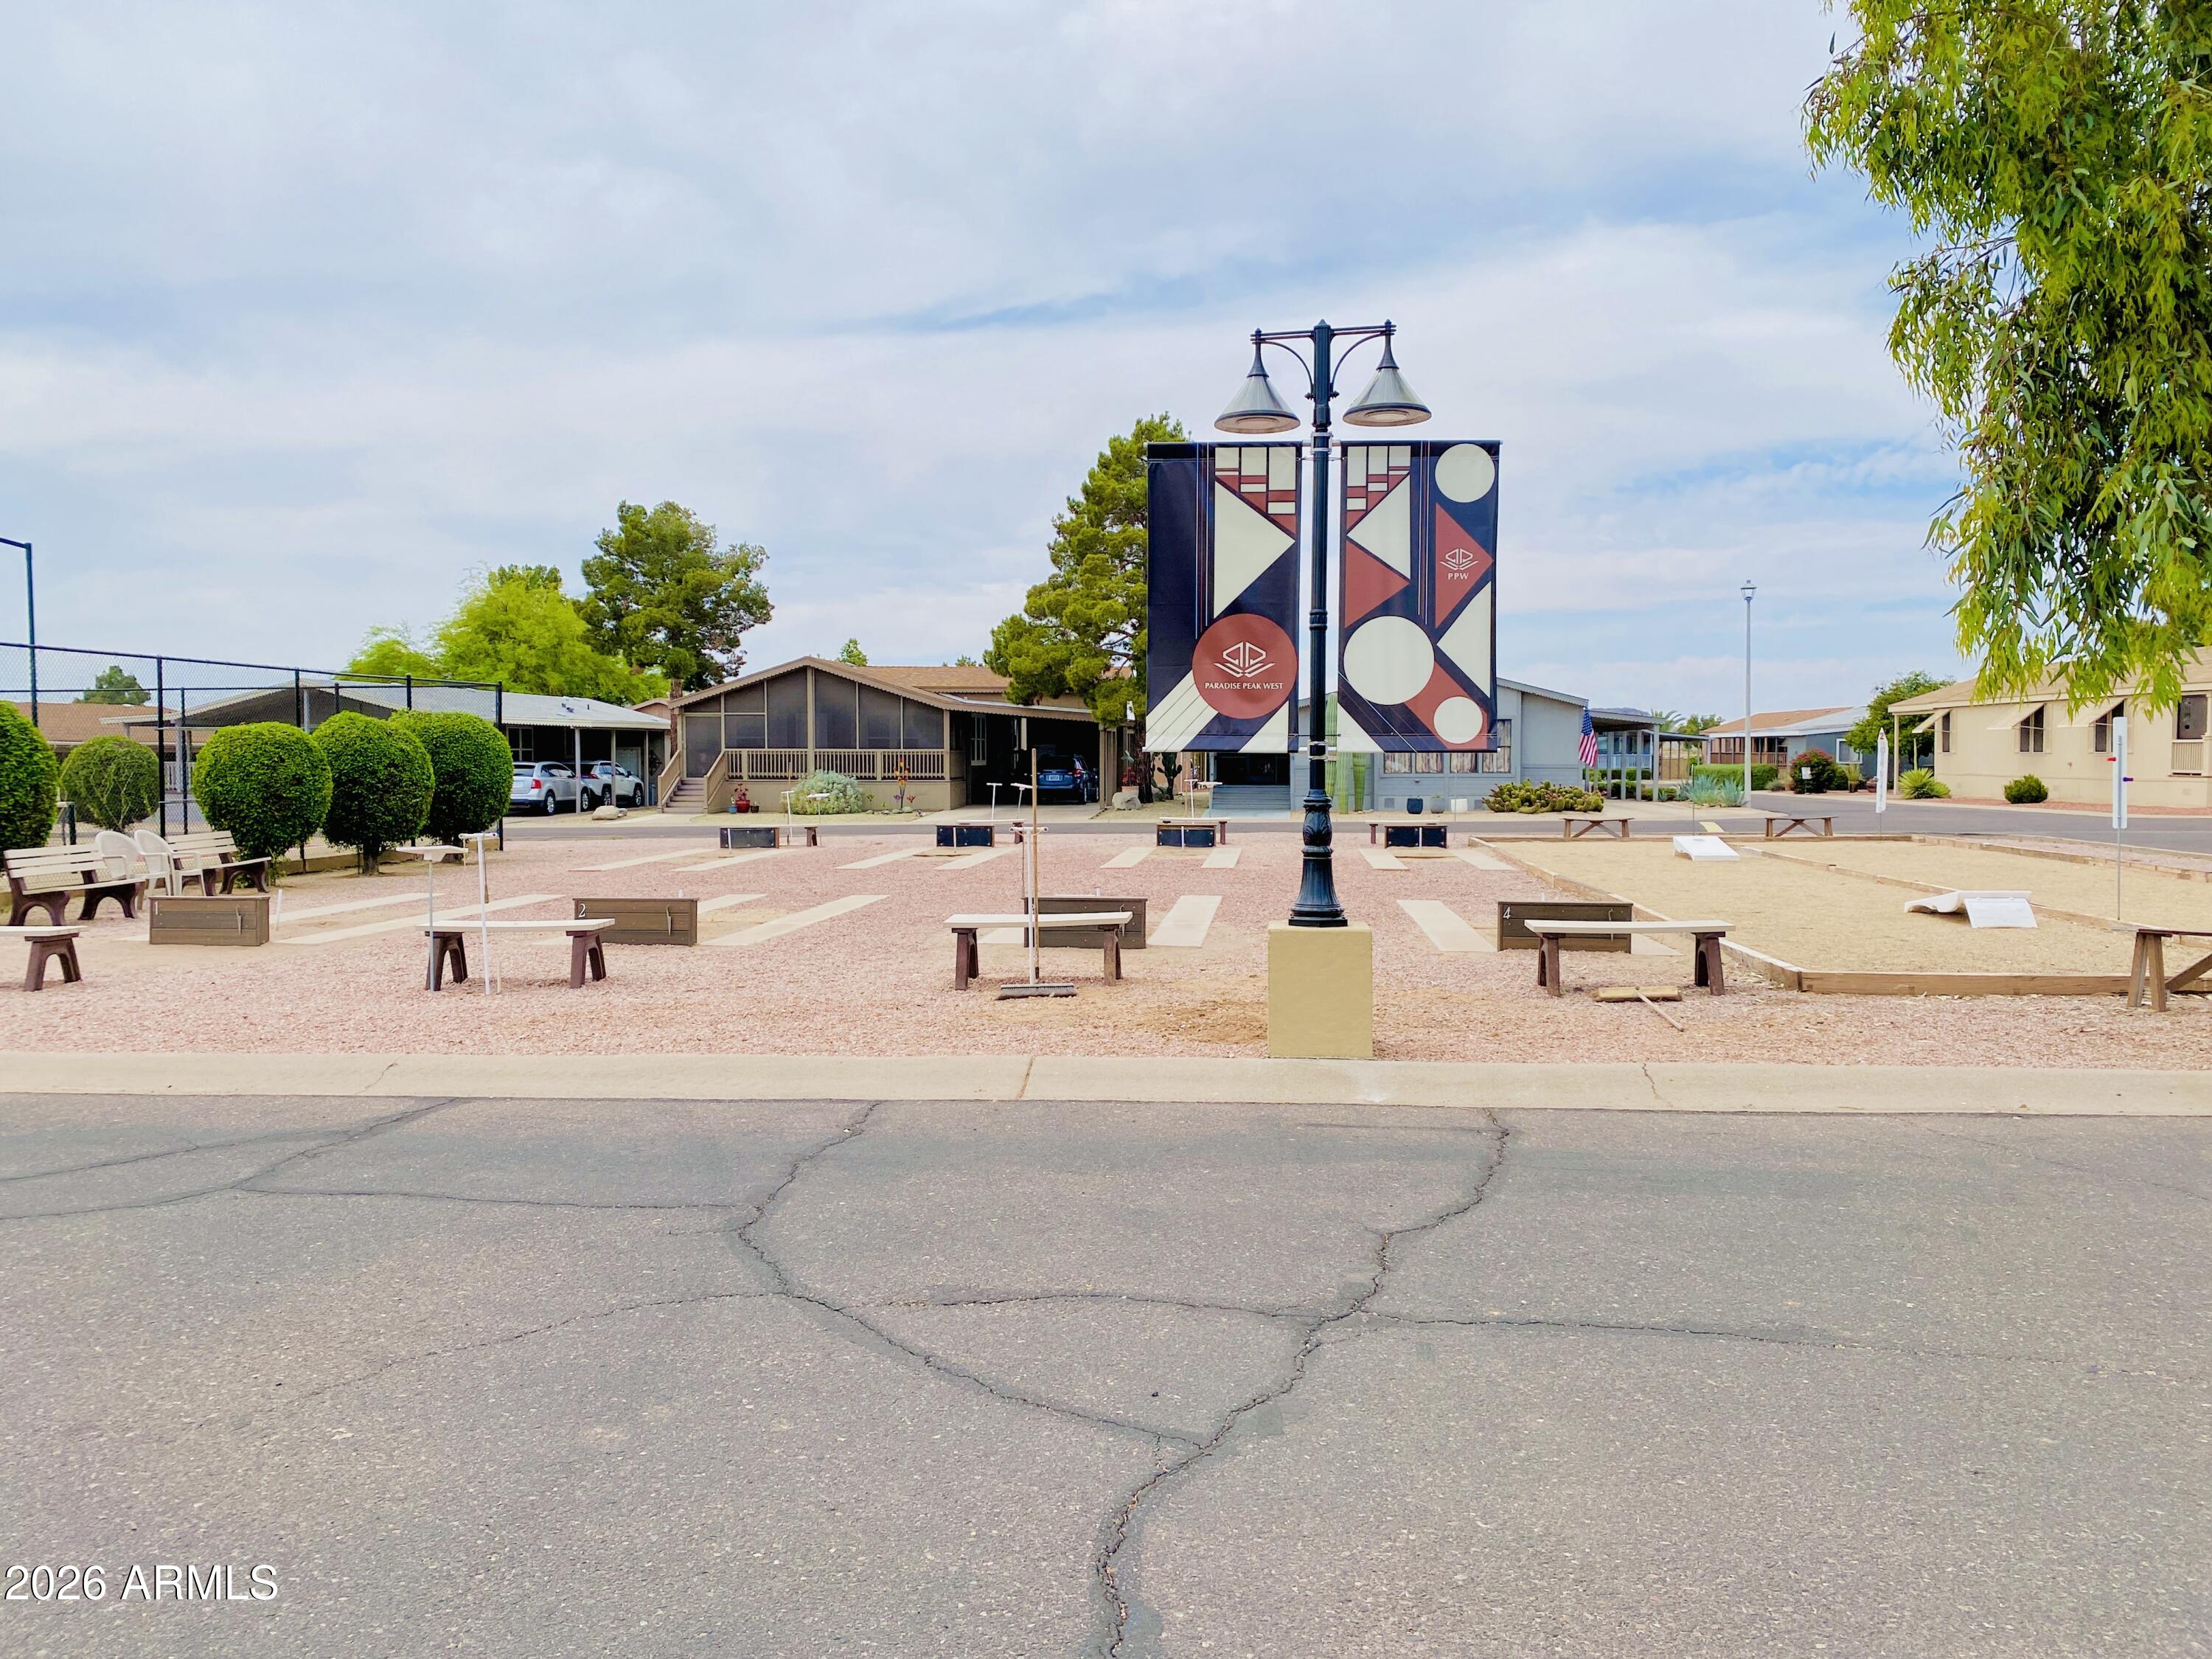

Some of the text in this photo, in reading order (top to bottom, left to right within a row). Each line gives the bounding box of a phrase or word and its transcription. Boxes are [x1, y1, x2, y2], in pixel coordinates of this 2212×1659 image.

[154, 901, 159, 914] 1
[578, 903, 586, 917] 2
[1503, 906, 1511, 919] 4
